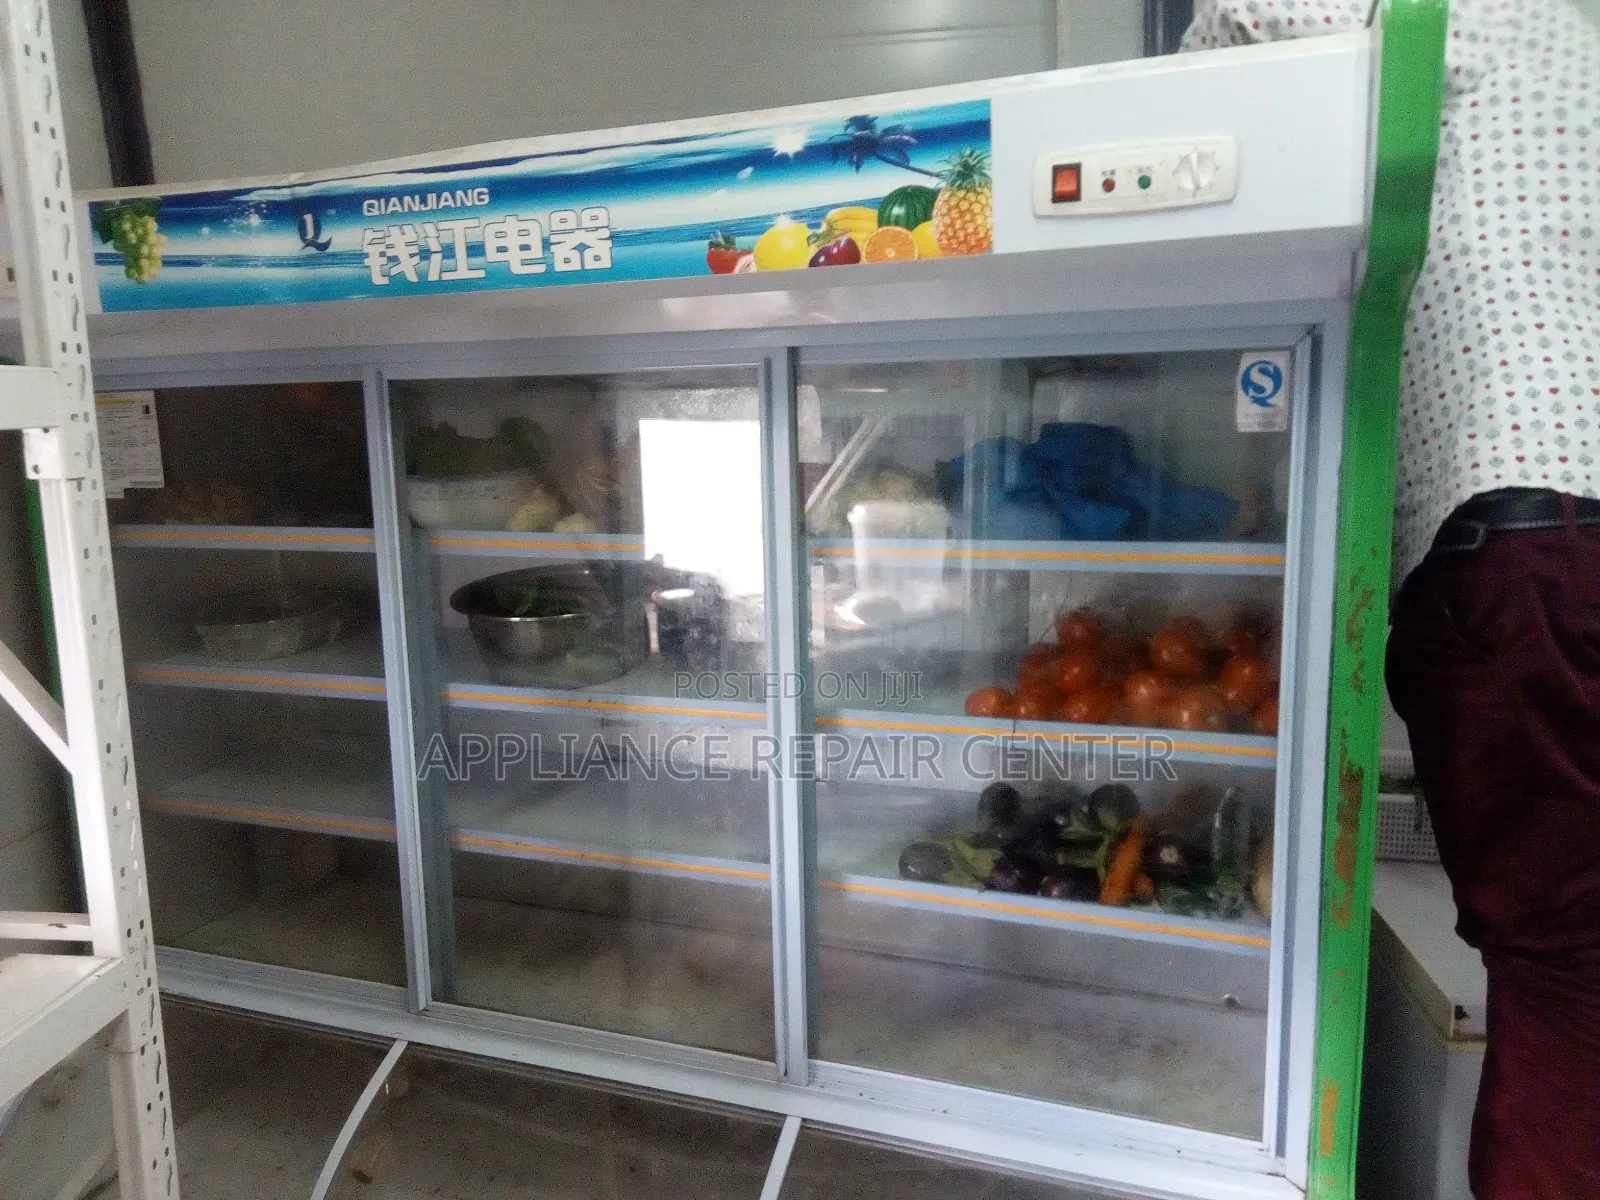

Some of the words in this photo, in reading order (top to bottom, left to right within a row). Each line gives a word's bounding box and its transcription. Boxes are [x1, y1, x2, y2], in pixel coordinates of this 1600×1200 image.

[363, 187, 490, 216] QIANJIANG
[362, 206, 613, 285] 钱江电器
